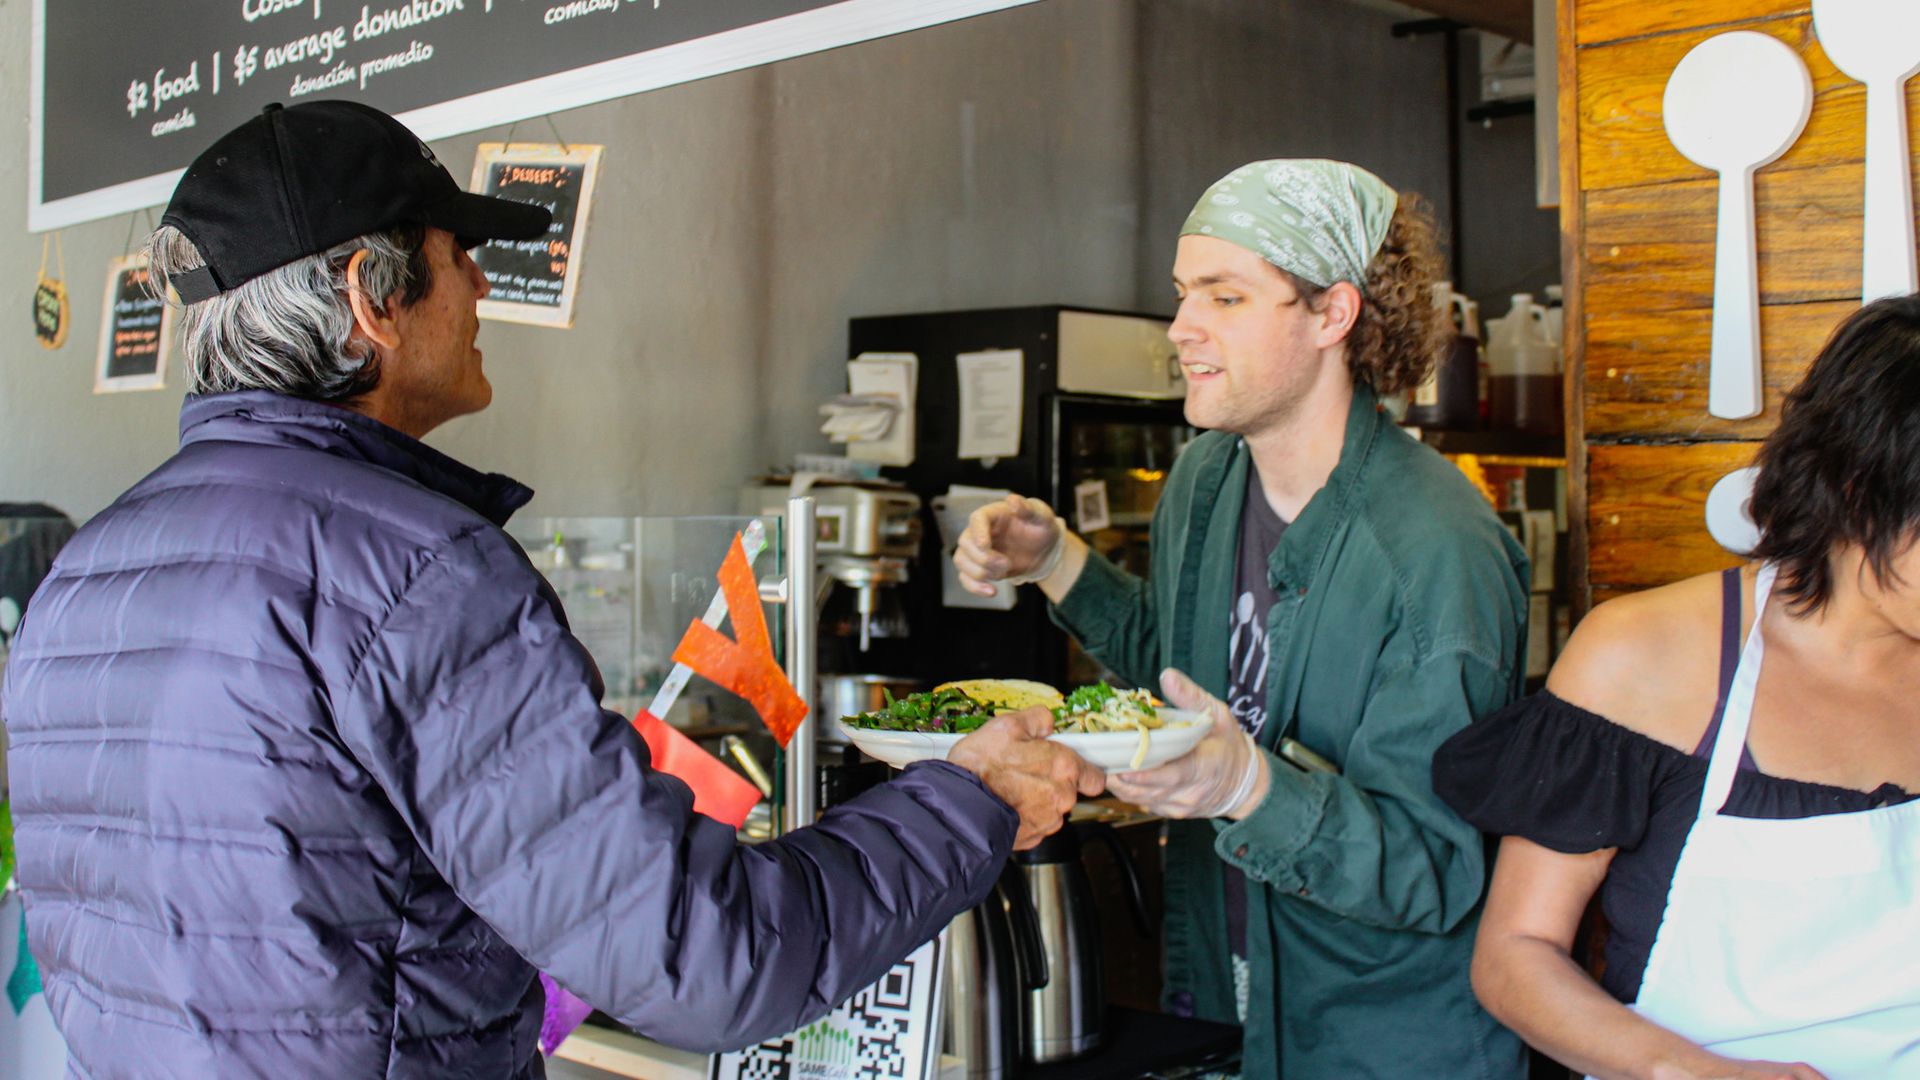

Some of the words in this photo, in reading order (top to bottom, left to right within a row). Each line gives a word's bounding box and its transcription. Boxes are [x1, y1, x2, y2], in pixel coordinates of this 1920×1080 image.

[127, 79, 148, 118] $2
[152, 61, 200, 112] food
[234, 45, 259, 86] $5
[264, 26, 347, 64] average
[353, 0, 464, 41] donation
[290, 60, 356, 97] donación
[360, 40, 433, 90] promedio
[152, 107, 196, 137] comida
[511, 167, 555, 185] DESSERT
